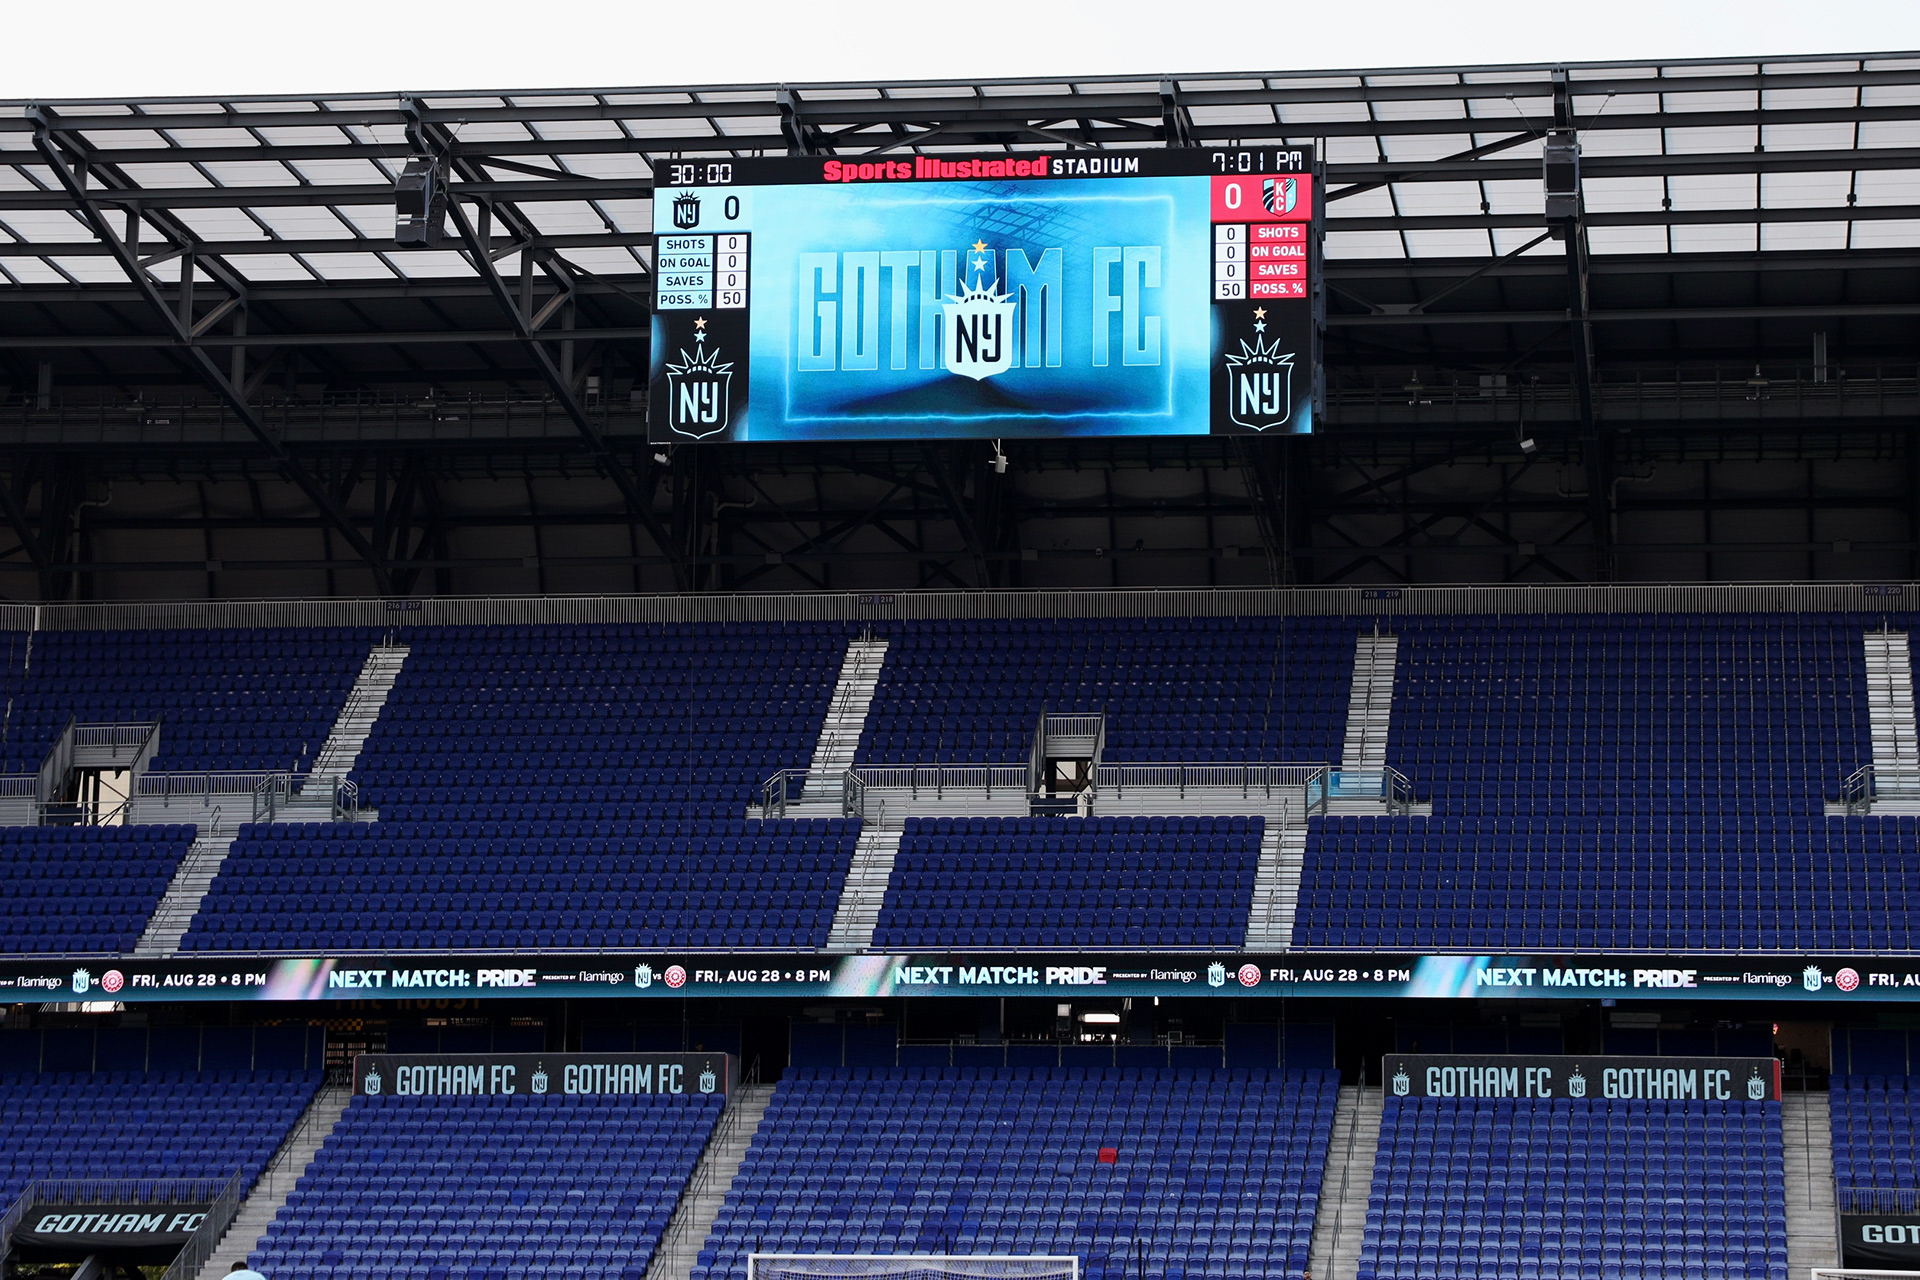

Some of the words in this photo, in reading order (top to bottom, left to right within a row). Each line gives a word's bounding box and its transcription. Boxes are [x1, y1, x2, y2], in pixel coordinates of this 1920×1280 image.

[823, 160, 912, 182] Sports
[915, 156, 1048, 179] Illustrated
[1053, 157, 1139, 175] STADIUM
[1212, 152, 1264, 172] 7:01
[1276, 151, 1302, 171] PM
[670, 163, 732, 184] 30:00
[1225, 183, 1242, 209] 0
[724, 195, 740, 220] 0
[1227, 227, 1235, 241] 0
[1258, 227, 1299, 238] SHOTS
[666, 239, 705, 250] SHOTS
[728, 237, 737, 250] 0
[1227, 246, 1235, 259] 0
[1251, 246, 1269, 257] ON
[1272, 245, 1305, 257] GOAL
[659, 258, 676, 269] ON
[679, 256, 710, 268] GOAL
[728, 255, 737, 268] 0
[1227, 264, 1235, 278] 0
[1258, 264, 1298, 275] SAVES
[665, 276, 704, 286] SAVES
[728, 273, 737, 286] 0
[1222, 283, 1240, 297] 50
[1253, 283, 1289, 295] POSS.
[1292, 282, 1303, 294] %
[660, 294, 694, 305] POSS.
[698, 294, 709, 304] %
[723, 292, 740, 305] 50
[1092, 246, 1161, 366] FC
[956, 313, 1002, 364] NY
[1240, 372, 1280, 415] NY
[680, 382, 719, 424] NY
[17, 976, 62, 990] flamingo
[132, 974, 159, 988] FRI,
[163, 974, 193, 987] AUG
[197, 974, 216, 986] 28
[231, 974, 241, 986] 8
[245, 974, 266, 986] PM
[329, 969, 386, 988] NEXT
[392, 969, 471, 988] MATCH:
[477, 969, 537, 987] PRIDE
[579, 970, 624, 985] flamingo
[695, 970, 723, 984] FRI,
[726, 970, 757, 982] AUG
[761, 970, 780, 982] 28
[795, 970, 806, 982] 8
[809, 970, 831, 982] PM
[894, 966, 953, 984] NEXT
[959, 966, 1039, 984] MATCH:
[1045, 966, 1107, 985] PRIDE
[1150, 968, 1197, 983] flamingo
[1270, 969, 1299, 983] FRI,
[1302, 969, 1334, 981] AUG
[1338, 969, 1358, 981] 28
[1373, 969, 1384, 982] 8
[1388, 969, 1410, 982] PM
[1476, 968, 1537, 986] NEXT
[1542, 968, 1627, 987] MATCH:
[1633, 969, 1697, 988] PRIDE
[1743, 972, 1792, 987] flamingo
[1869, 973, 1899, 988] FRI,
[396, 1065, 484, 1096] GOTHAM
[490, 1065, 516, 1095] FC
[564, 1064, 652, 1094] GOTHAM
[658, 1063, 684, 1094] FC
[1426, 1066, 1518, 1098] GOTHAM
[1525, 1067, 1552, 1099] FC
[1603, 1068, 1697, 1100] GOTHAM
[1704, 1069, 1731, 1100] FC
[34, 1213, 166, 1233] GOTHAM
[166, 1213, 208, 1232] FC
